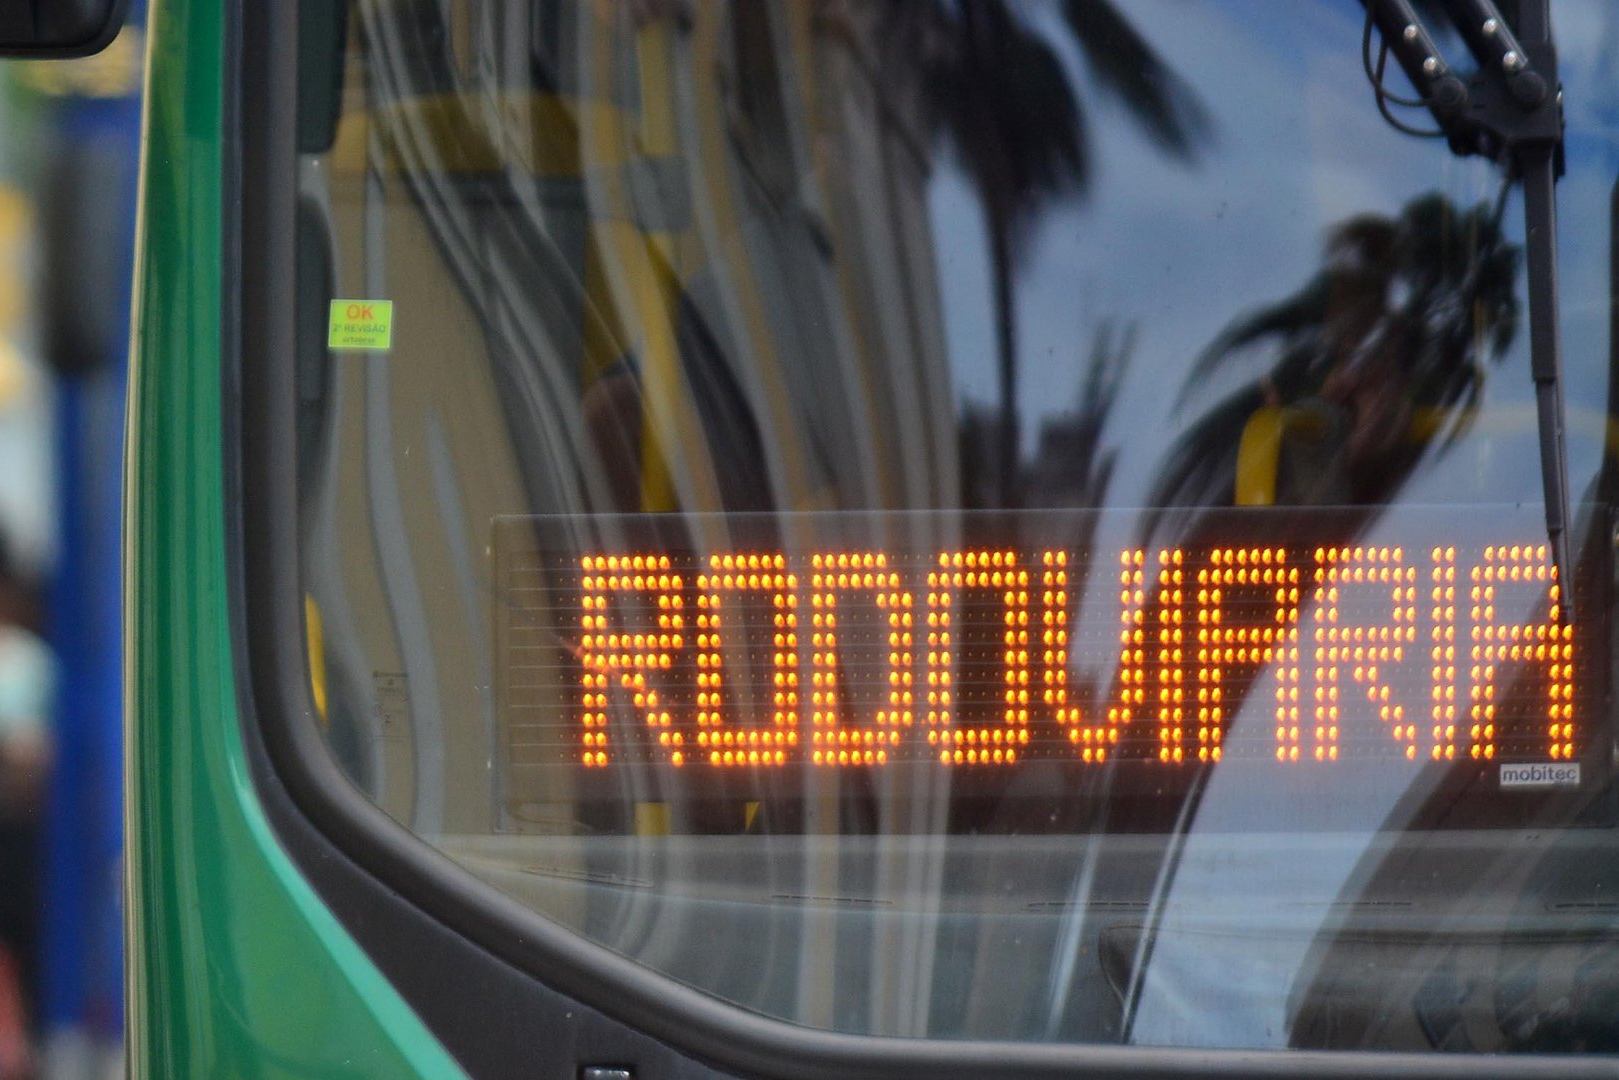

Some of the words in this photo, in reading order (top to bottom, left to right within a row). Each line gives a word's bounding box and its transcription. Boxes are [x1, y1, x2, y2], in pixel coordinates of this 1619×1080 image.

[346, 303, 375, 320] OK
[581, 546, 1575, 766] RODOVIARIA
[1503, 765, 1576, 781] mobitec
